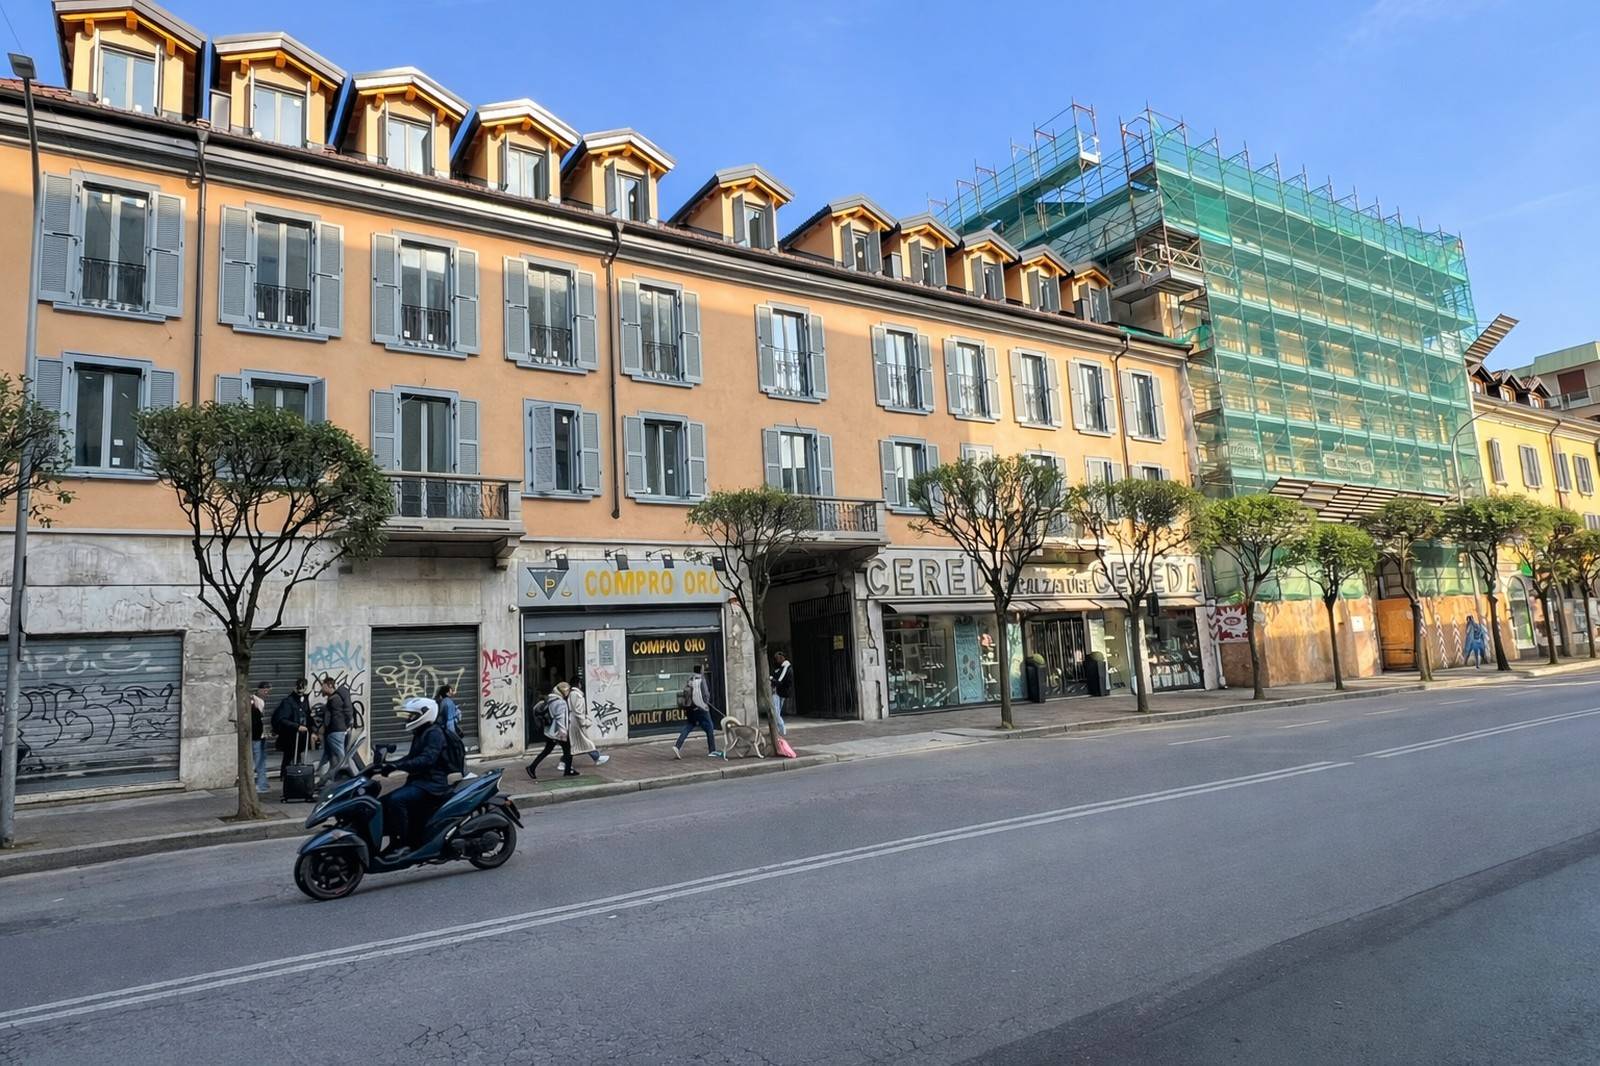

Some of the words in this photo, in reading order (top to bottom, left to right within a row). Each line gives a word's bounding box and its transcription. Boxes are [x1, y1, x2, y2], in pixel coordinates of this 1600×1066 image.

[584, 570, 674, 596] COMPRO
[632, 639, 680, 655] COMPRO
[684, 638, 706, 652] ORO
[629, 711, 662, 725] OUTLET
